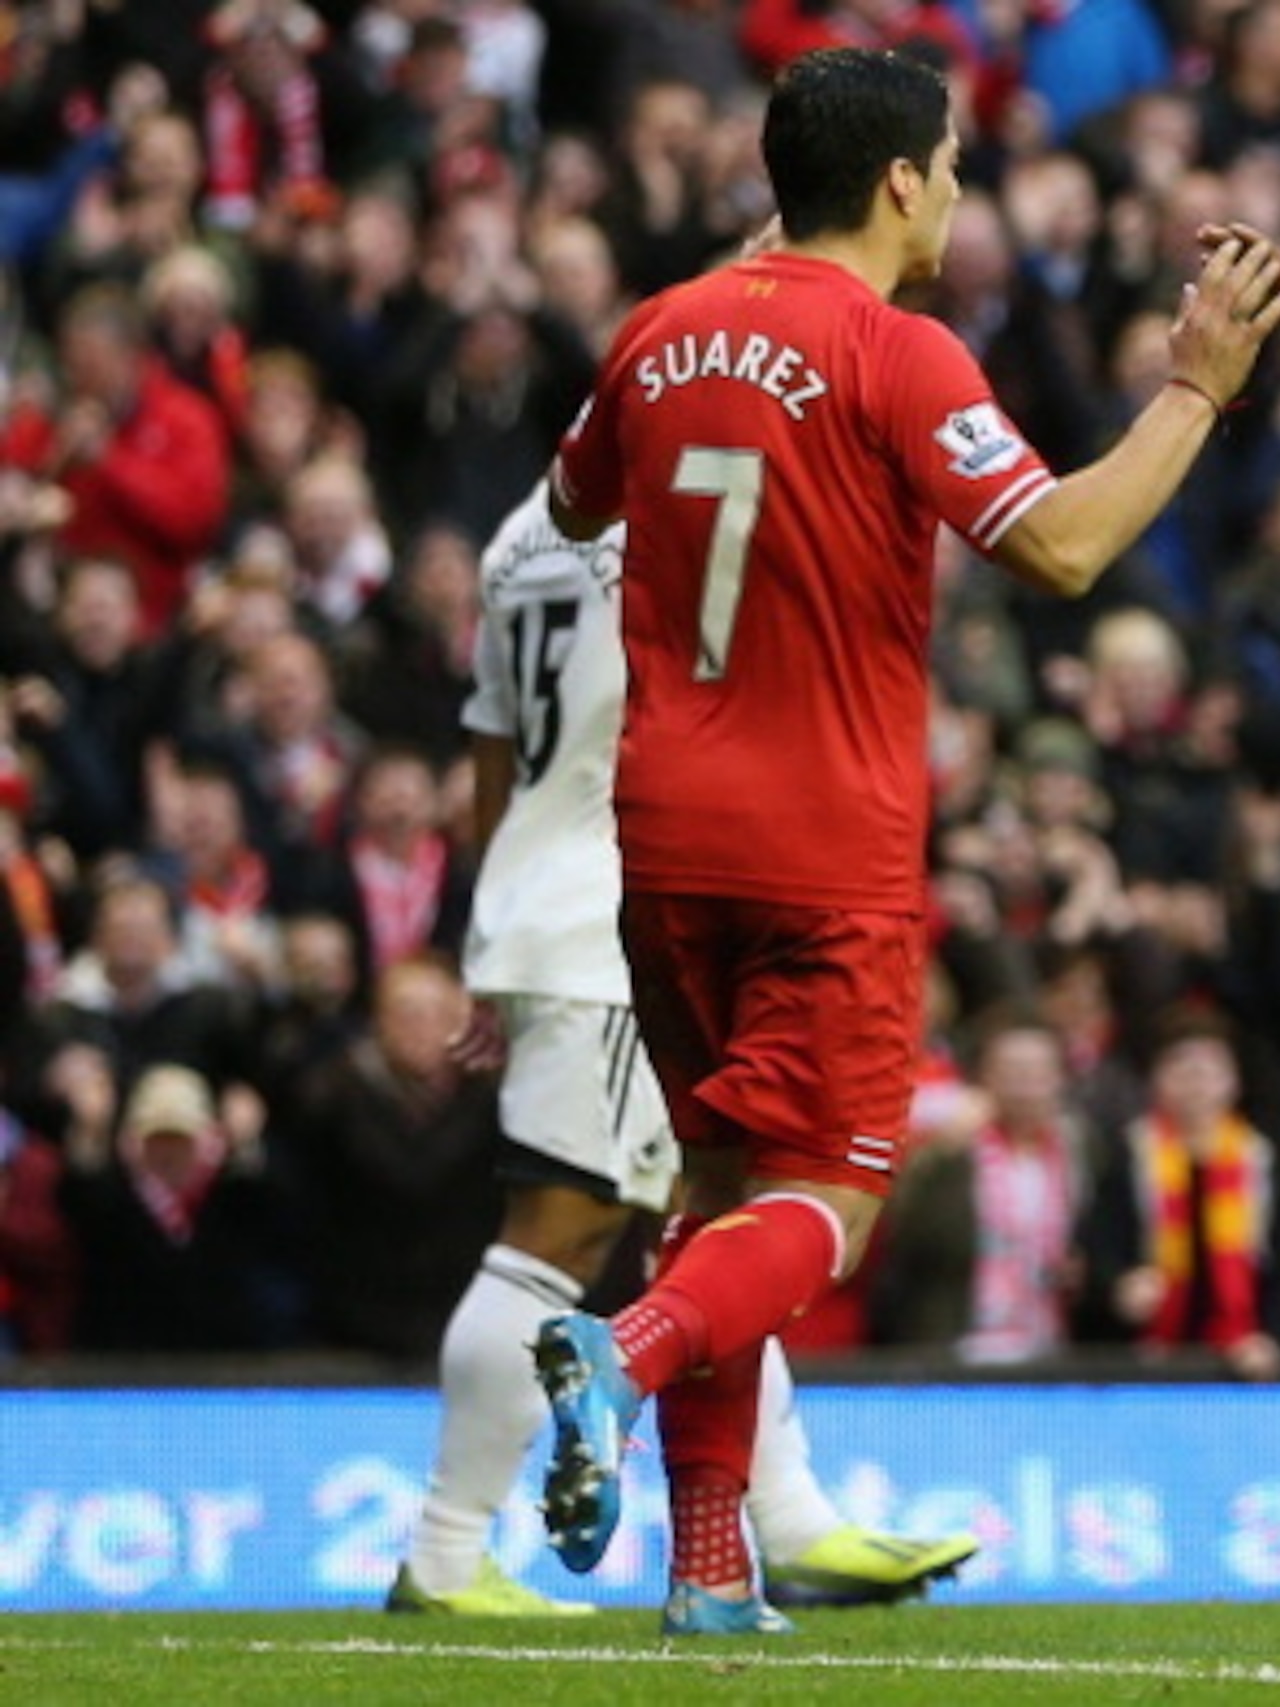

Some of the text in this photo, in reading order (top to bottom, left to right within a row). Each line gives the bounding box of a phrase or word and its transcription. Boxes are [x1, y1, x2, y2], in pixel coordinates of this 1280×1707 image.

[638, 330, 828, 421] SUAREZ
[671, 447, 764, 681] 7
[511, 601, 579, 786] 15
